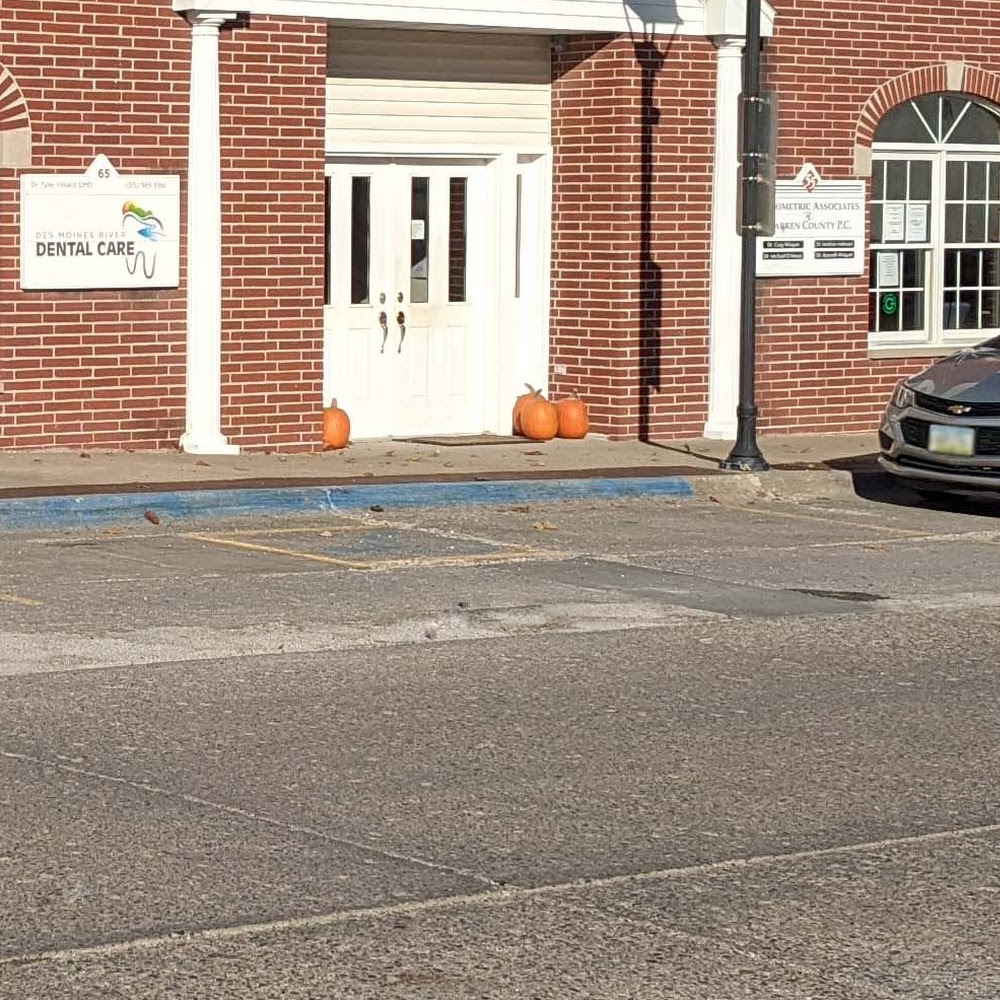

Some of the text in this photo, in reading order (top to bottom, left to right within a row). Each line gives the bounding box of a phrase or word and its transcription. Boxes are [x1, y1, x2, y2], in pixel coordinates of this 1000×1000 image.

[97, 168, 111, 179] 65
[803, 174, 817, 190] 55
[776, 202, 860, 210] OMETRIC ASSOCIATES
[776, 222, 800, 230] ARREN
[802, 220, 835, 230] COUNTY
[36, 231, 127, 239] DES MOINES RIVER
[36, 241, 135, 257] DENTAL CARE
